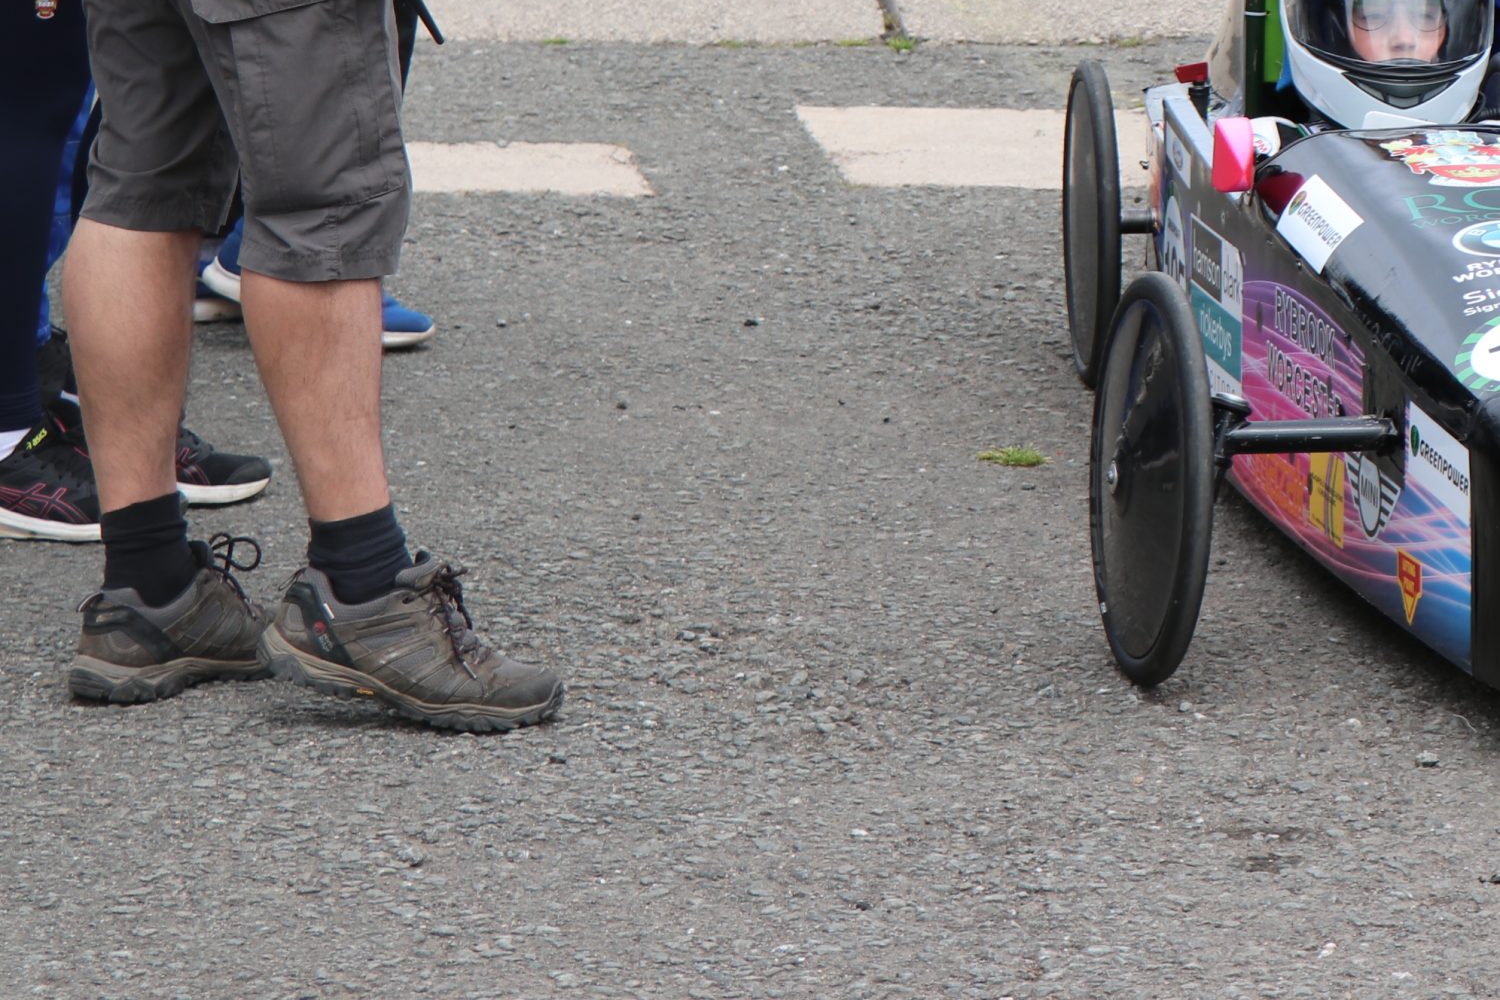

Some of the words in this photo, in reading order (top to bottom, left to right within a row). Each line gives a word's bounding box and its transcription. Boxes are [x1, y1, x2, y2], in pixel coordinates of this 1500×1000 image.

[1296, 202, 1343, 249] GREENPOWER
[1193, 228, 1221, 290] harrison
[1200, 303, 1232, 361] rickerbys
[1274, 286, 1336, 371] RYBROOK
[1360, 475, 1379, 508] MINI
[1420, 440, 1470, 497] GREENPOWER
